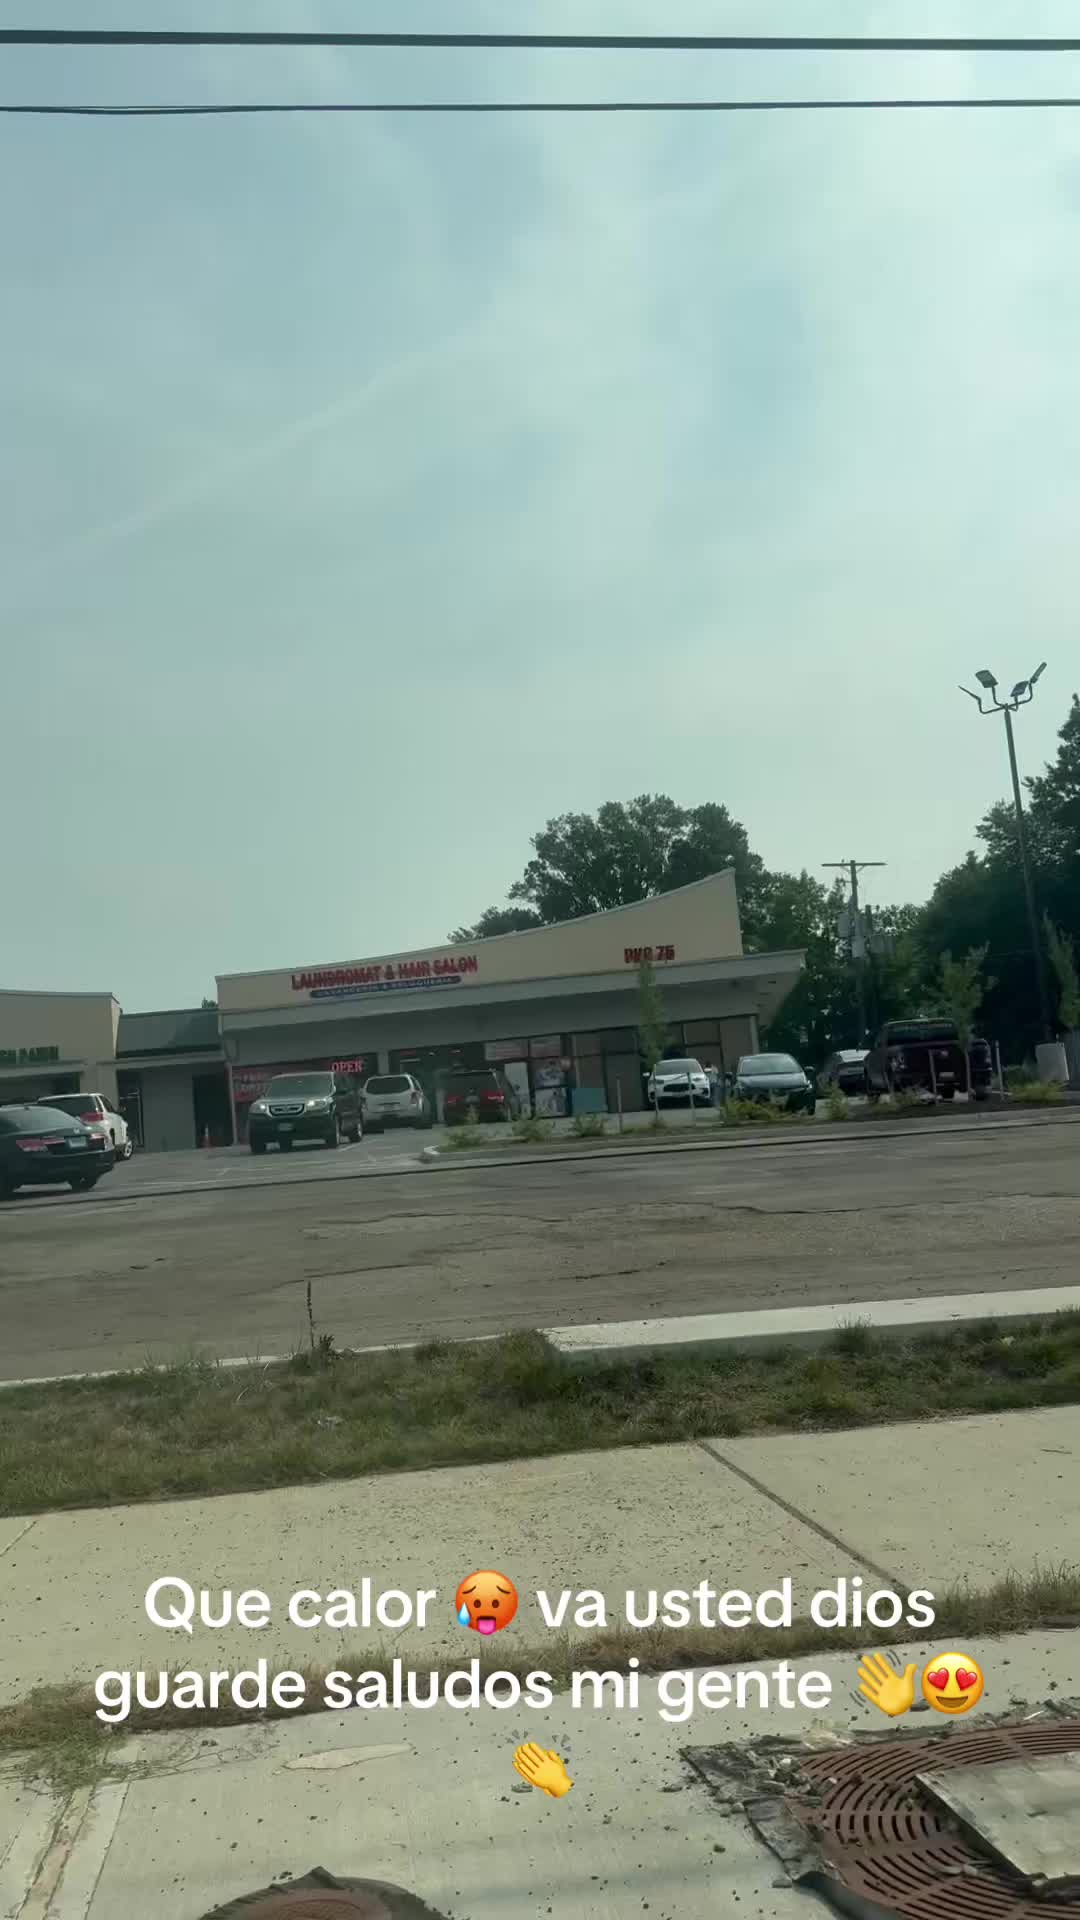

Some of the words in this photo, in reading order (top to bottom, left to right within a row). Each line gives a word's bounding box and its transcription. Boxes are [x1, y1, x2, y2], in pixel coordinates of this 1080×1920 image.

[291, 965, 381, 990] LAUNDROMAT
[384, 964, 395, 980] &
[398, 961, 431, 979] HAIR
[433, 955, 478, 974] SALON
[331, 1060, 363, 1073] OPEN
